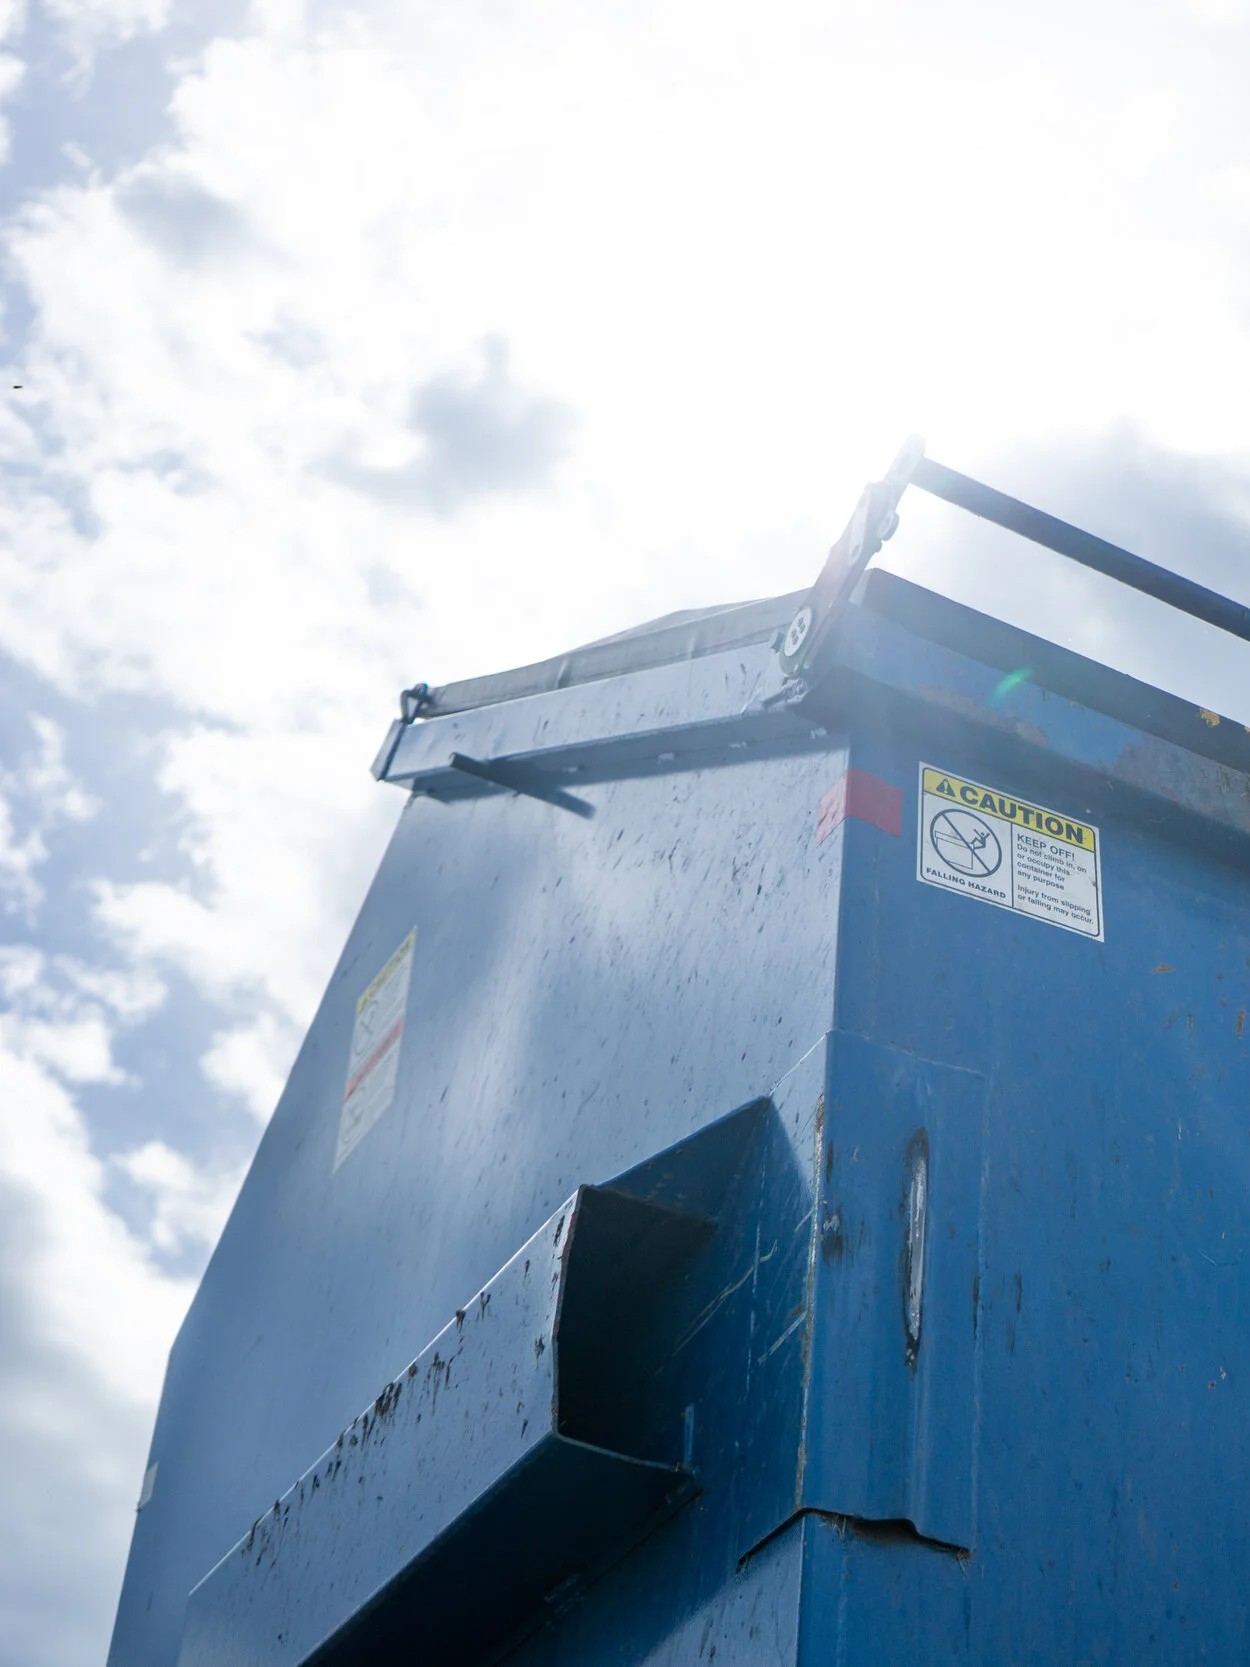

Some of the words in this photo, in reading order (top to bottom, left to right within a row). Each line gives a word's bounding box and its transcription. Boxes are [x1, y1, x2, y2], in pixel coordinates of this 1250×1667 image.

[959, 786, 1084, 845] CAUTION
[1017, 833, 1047, 850] KEEP
[1049, 845, 1075, 861] OFF!
[1017, 843, 1028, 853] Do
[1029, 848, 1042, 858] not
[1043, 853, 1065, 866] climb
[1077, 866, 1087, 874] on
[1017, 862, 1053, 878] container
[1054, 873, 1066, 882] for
[1017, 870, 1031, 879] any
[1033, 876, 1065, 891] purpose
[1027, 856, 1055, 872] occupy
[1056, 865, 1071, 876] this
[926, 867, 966, 886] FALLING
[968, 881, 1007, 899] HAZARD
[1017, 884, 1040, 899] Injury
[1041, 893, 1059, 904] from
[1060, 898, 1091, 916] slipping
[1017, 893, 1026, 901] or
[1027, 895, 1052, 911] falling
[1053, 906, 1070, 917] may
[1071, 912, 1095, 925] occur.
